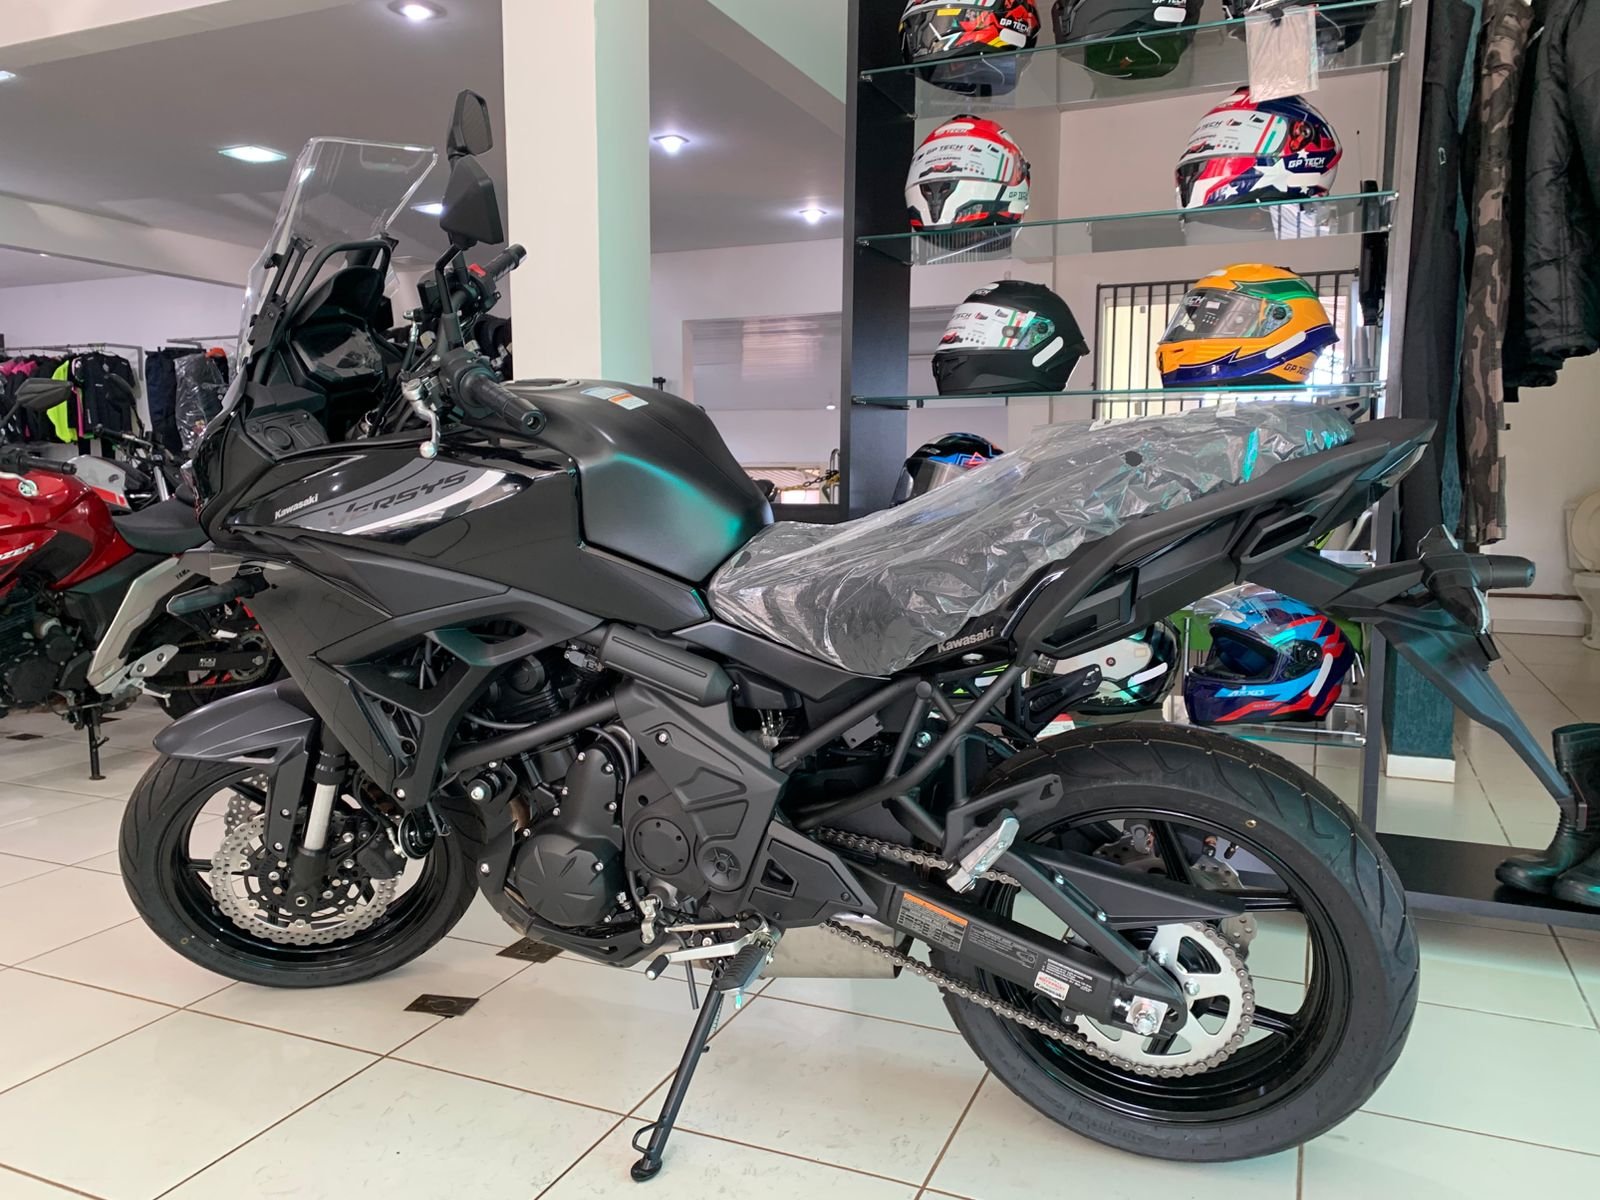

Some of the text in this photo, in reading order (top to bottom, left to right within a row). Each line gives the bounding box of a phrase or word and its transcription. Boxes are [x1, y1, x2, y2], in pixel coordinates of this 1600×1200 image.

[1000, 18, 1029, 33] GP TECH
[1288, 157, 1326, 168] GP TECH
[1284, 363, 1297, 372] GP
[274, 493, 319, 520] Kawasaki
[328, 470, 469, 528] VERSYS
[937, 626, 994, 653] Kawasaki
